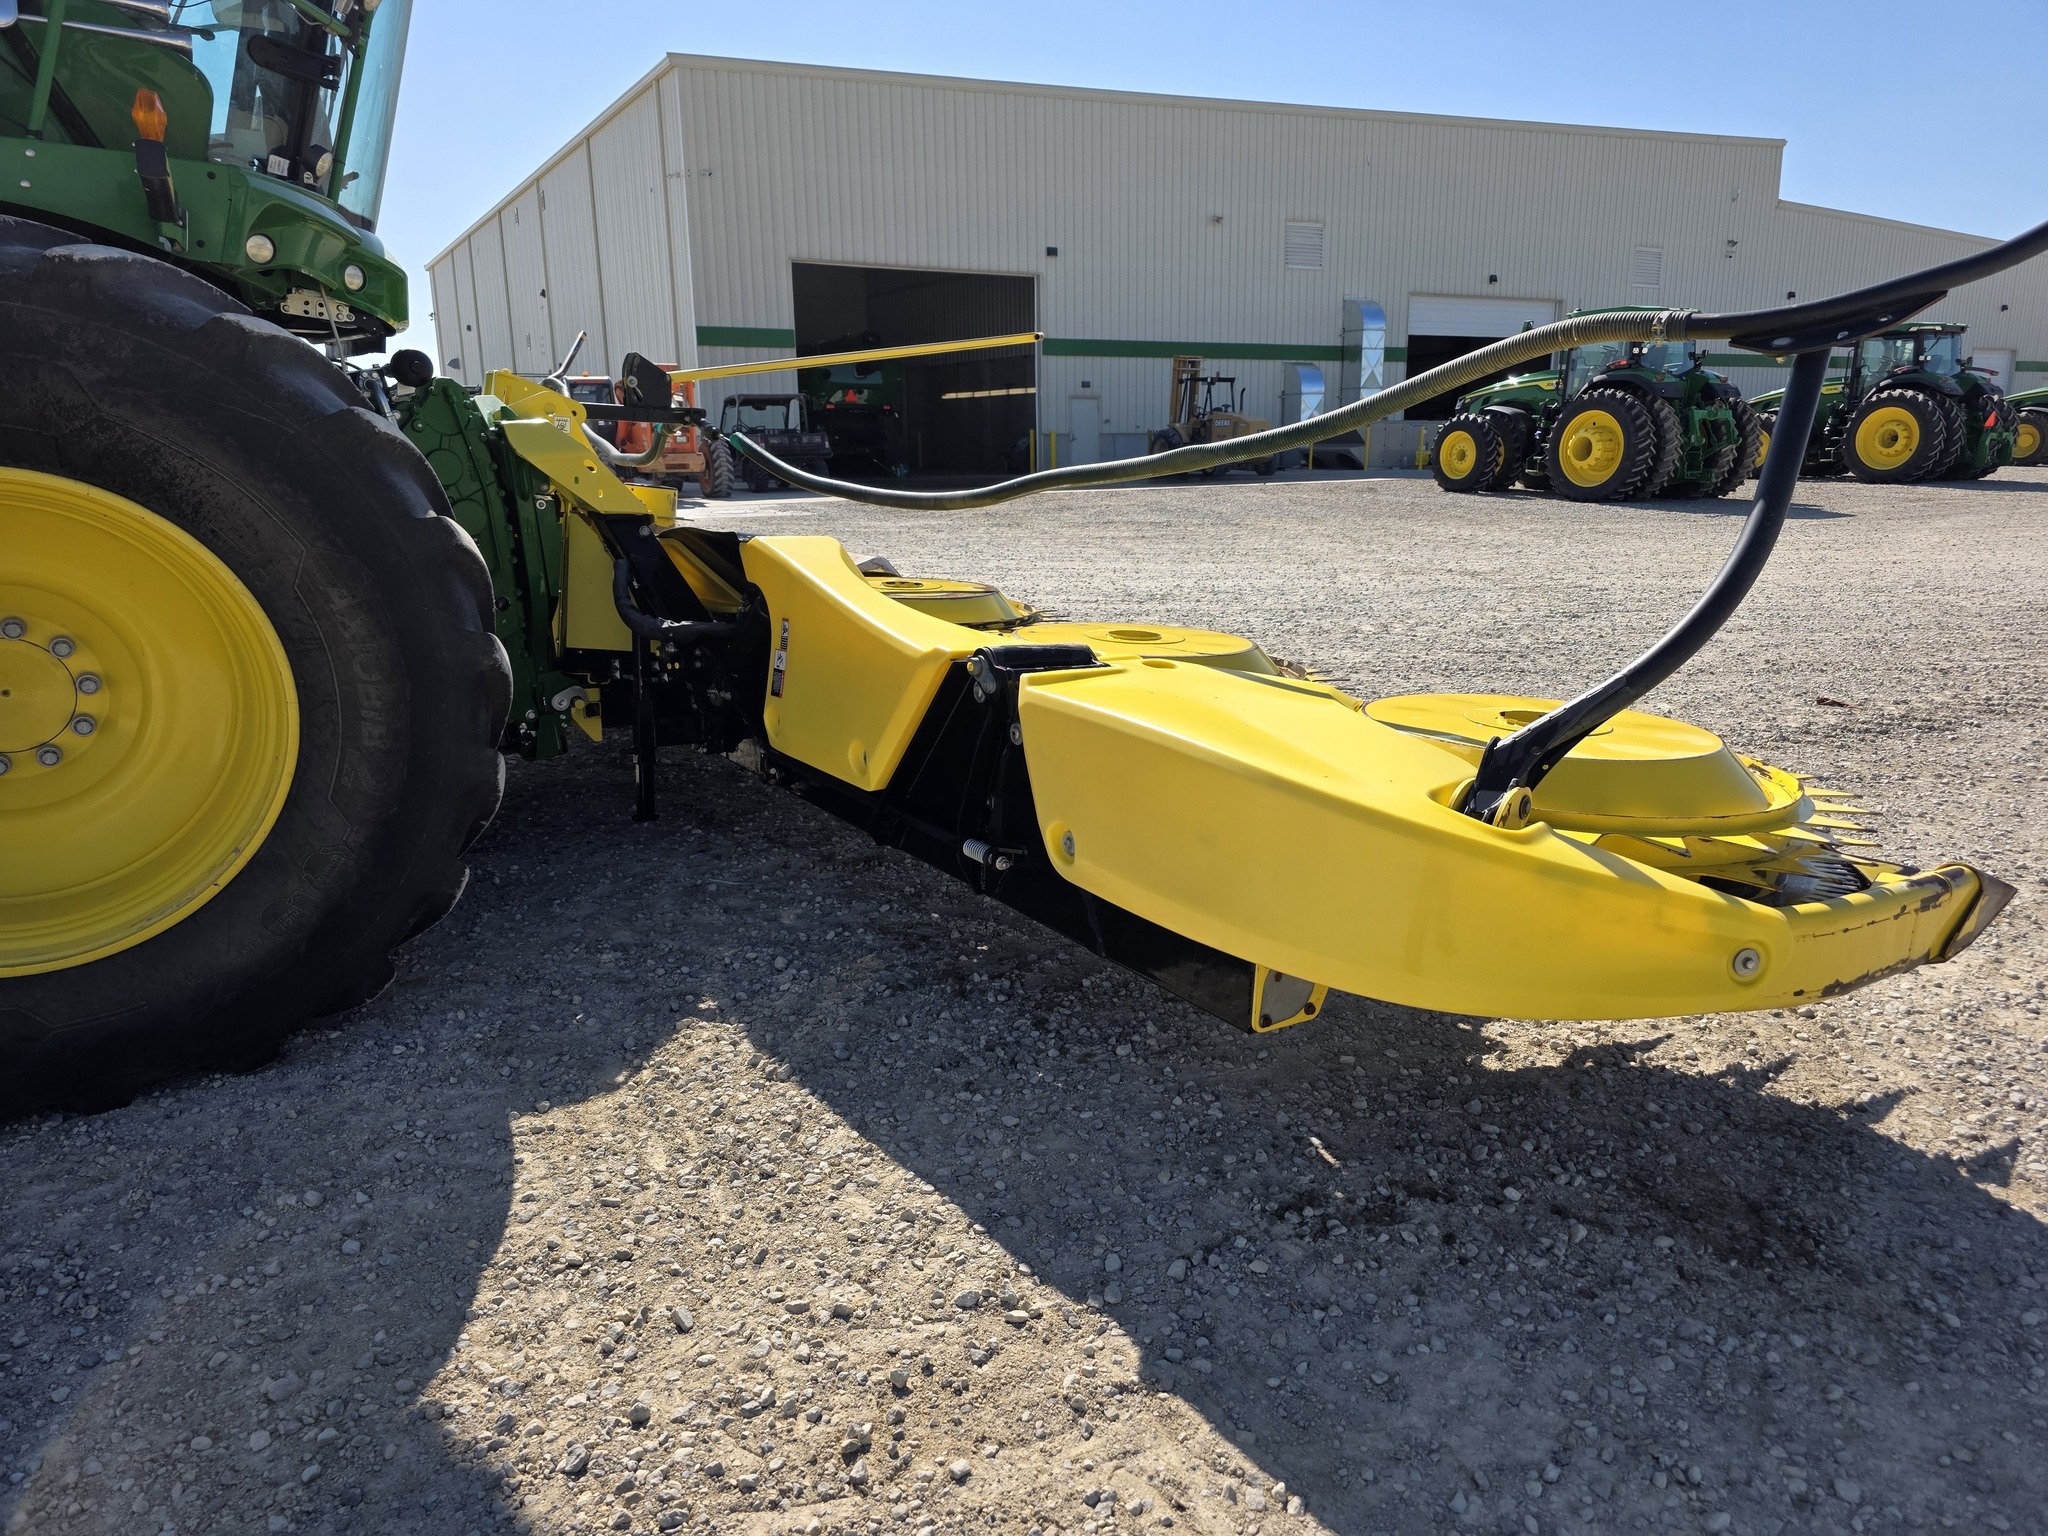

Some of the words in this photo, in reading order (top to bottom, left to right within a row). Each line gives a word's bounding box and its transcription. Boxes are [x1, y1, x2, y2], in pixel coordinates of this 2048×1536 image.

[1214, 419, 1231, 427] DEERE
[322, 585, 387, 748] AXIOBIB
[340, 748, 381, 795] 2
[280, 908, 301, 931] HIGH
